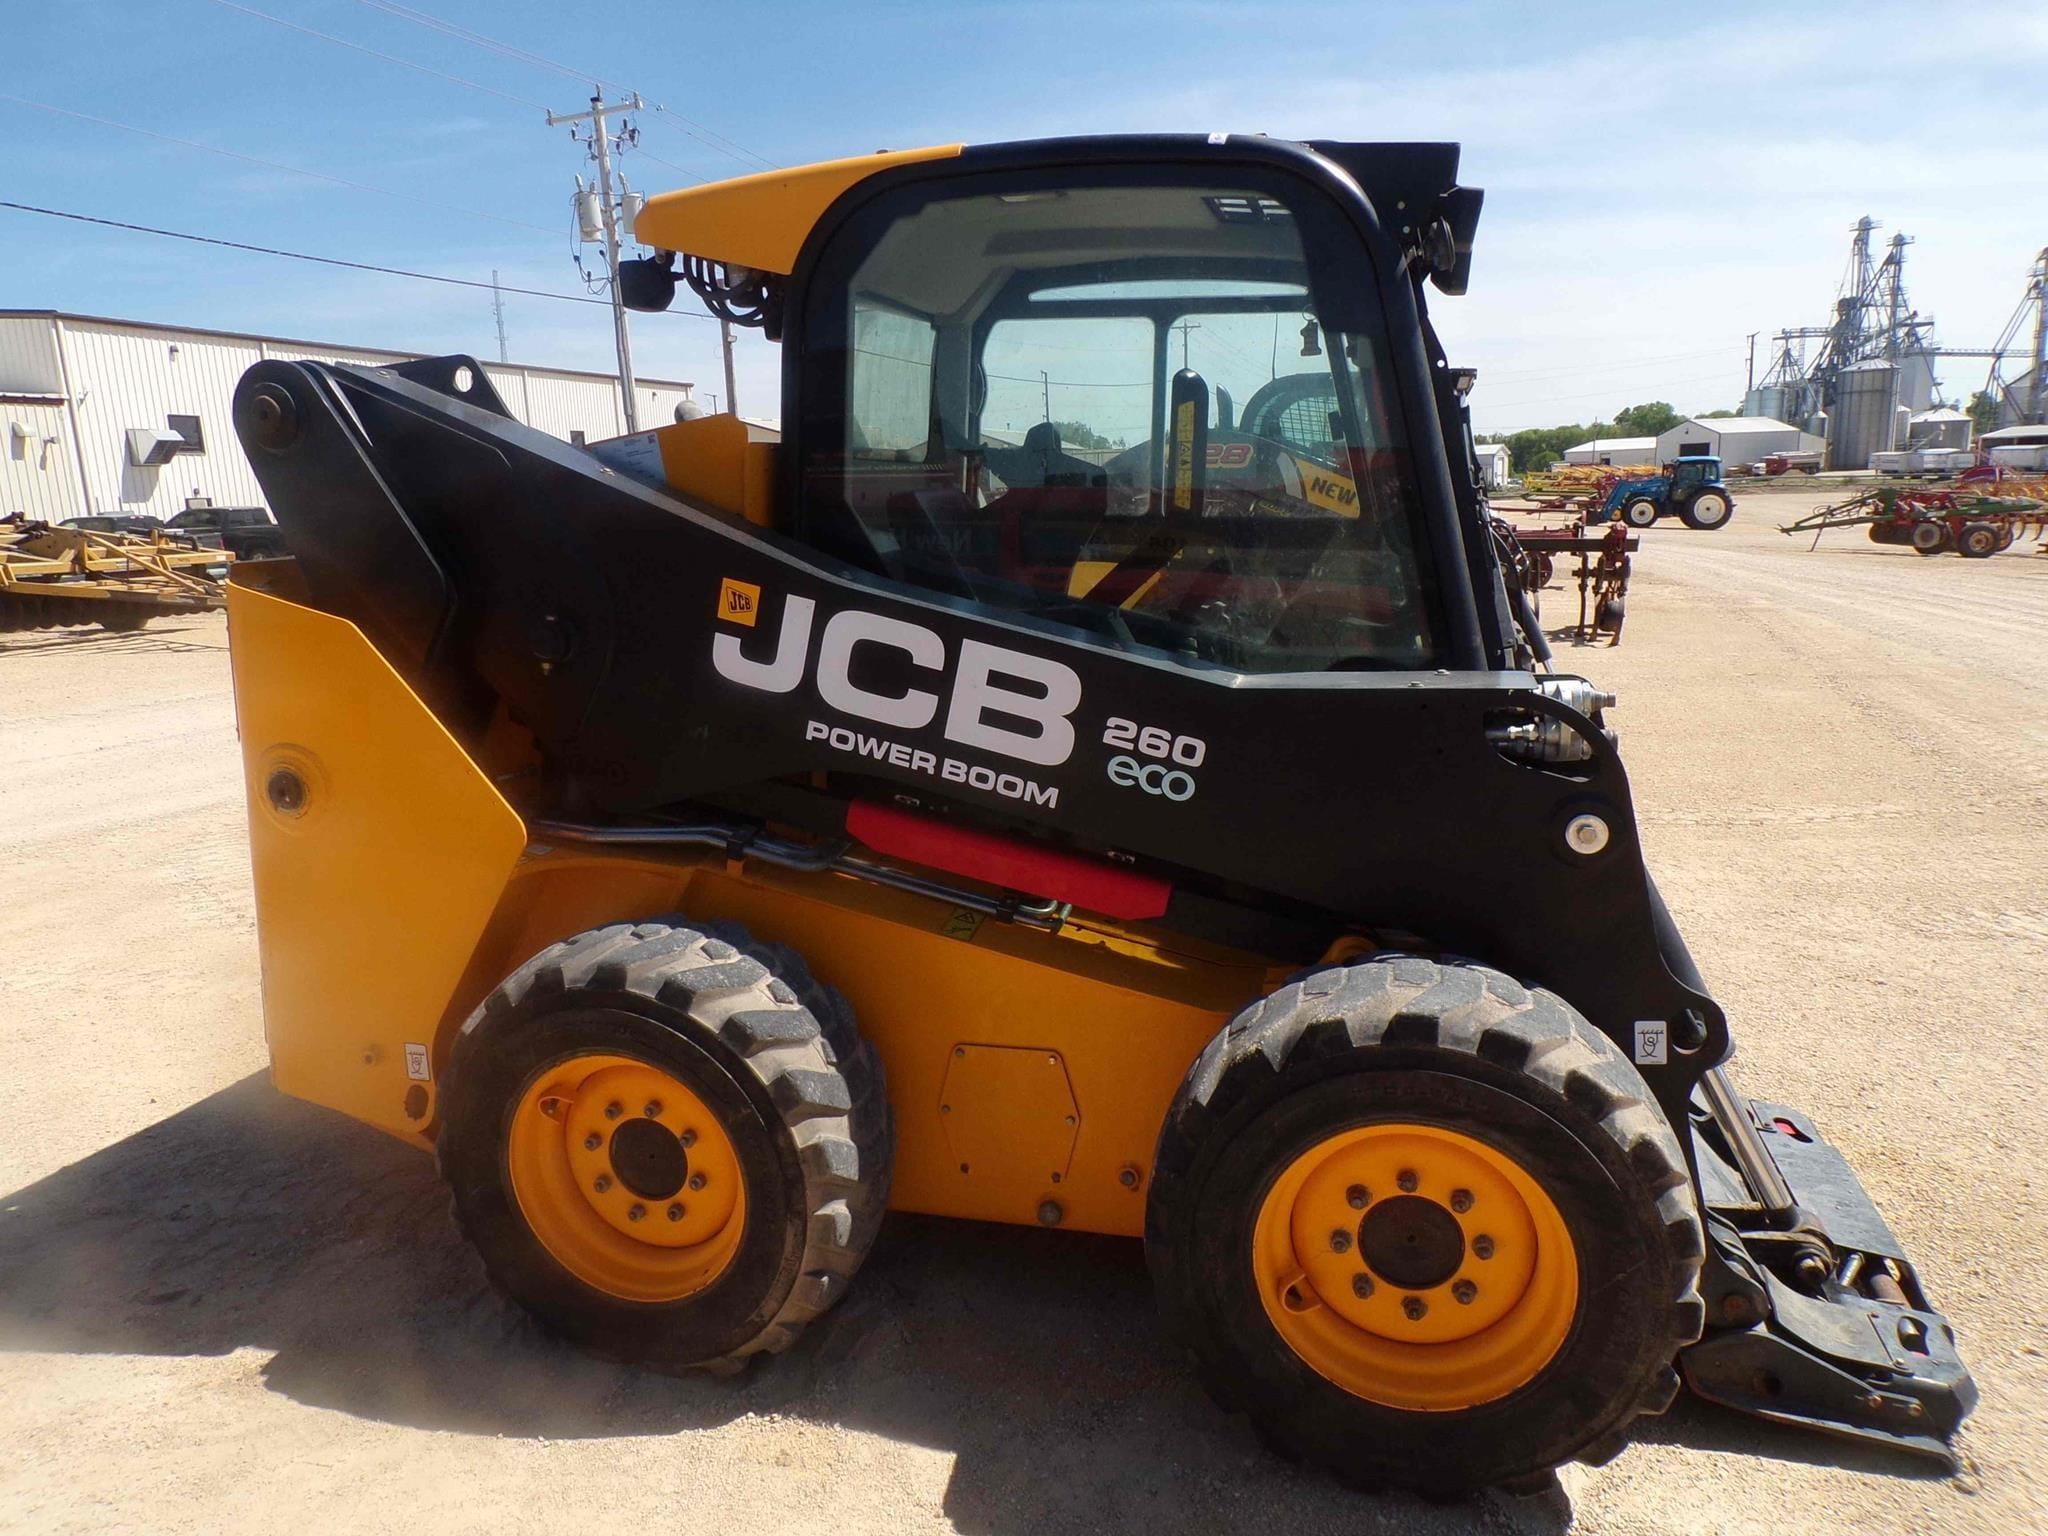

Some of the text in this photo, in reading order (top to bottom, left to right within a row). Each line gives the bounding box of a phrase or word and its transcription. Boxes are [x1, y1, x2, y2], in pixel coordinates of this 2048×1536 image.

[1311, 476, 1356, 505] NEW
[729, 590, 752, 612] JCB
[712, 593, 1082, 767] JCB
[805, 720, 1059, 809] POWER BOOM
[1102, 716, 1207, 768] 260
[1107, 754, 1196, 802] eco
